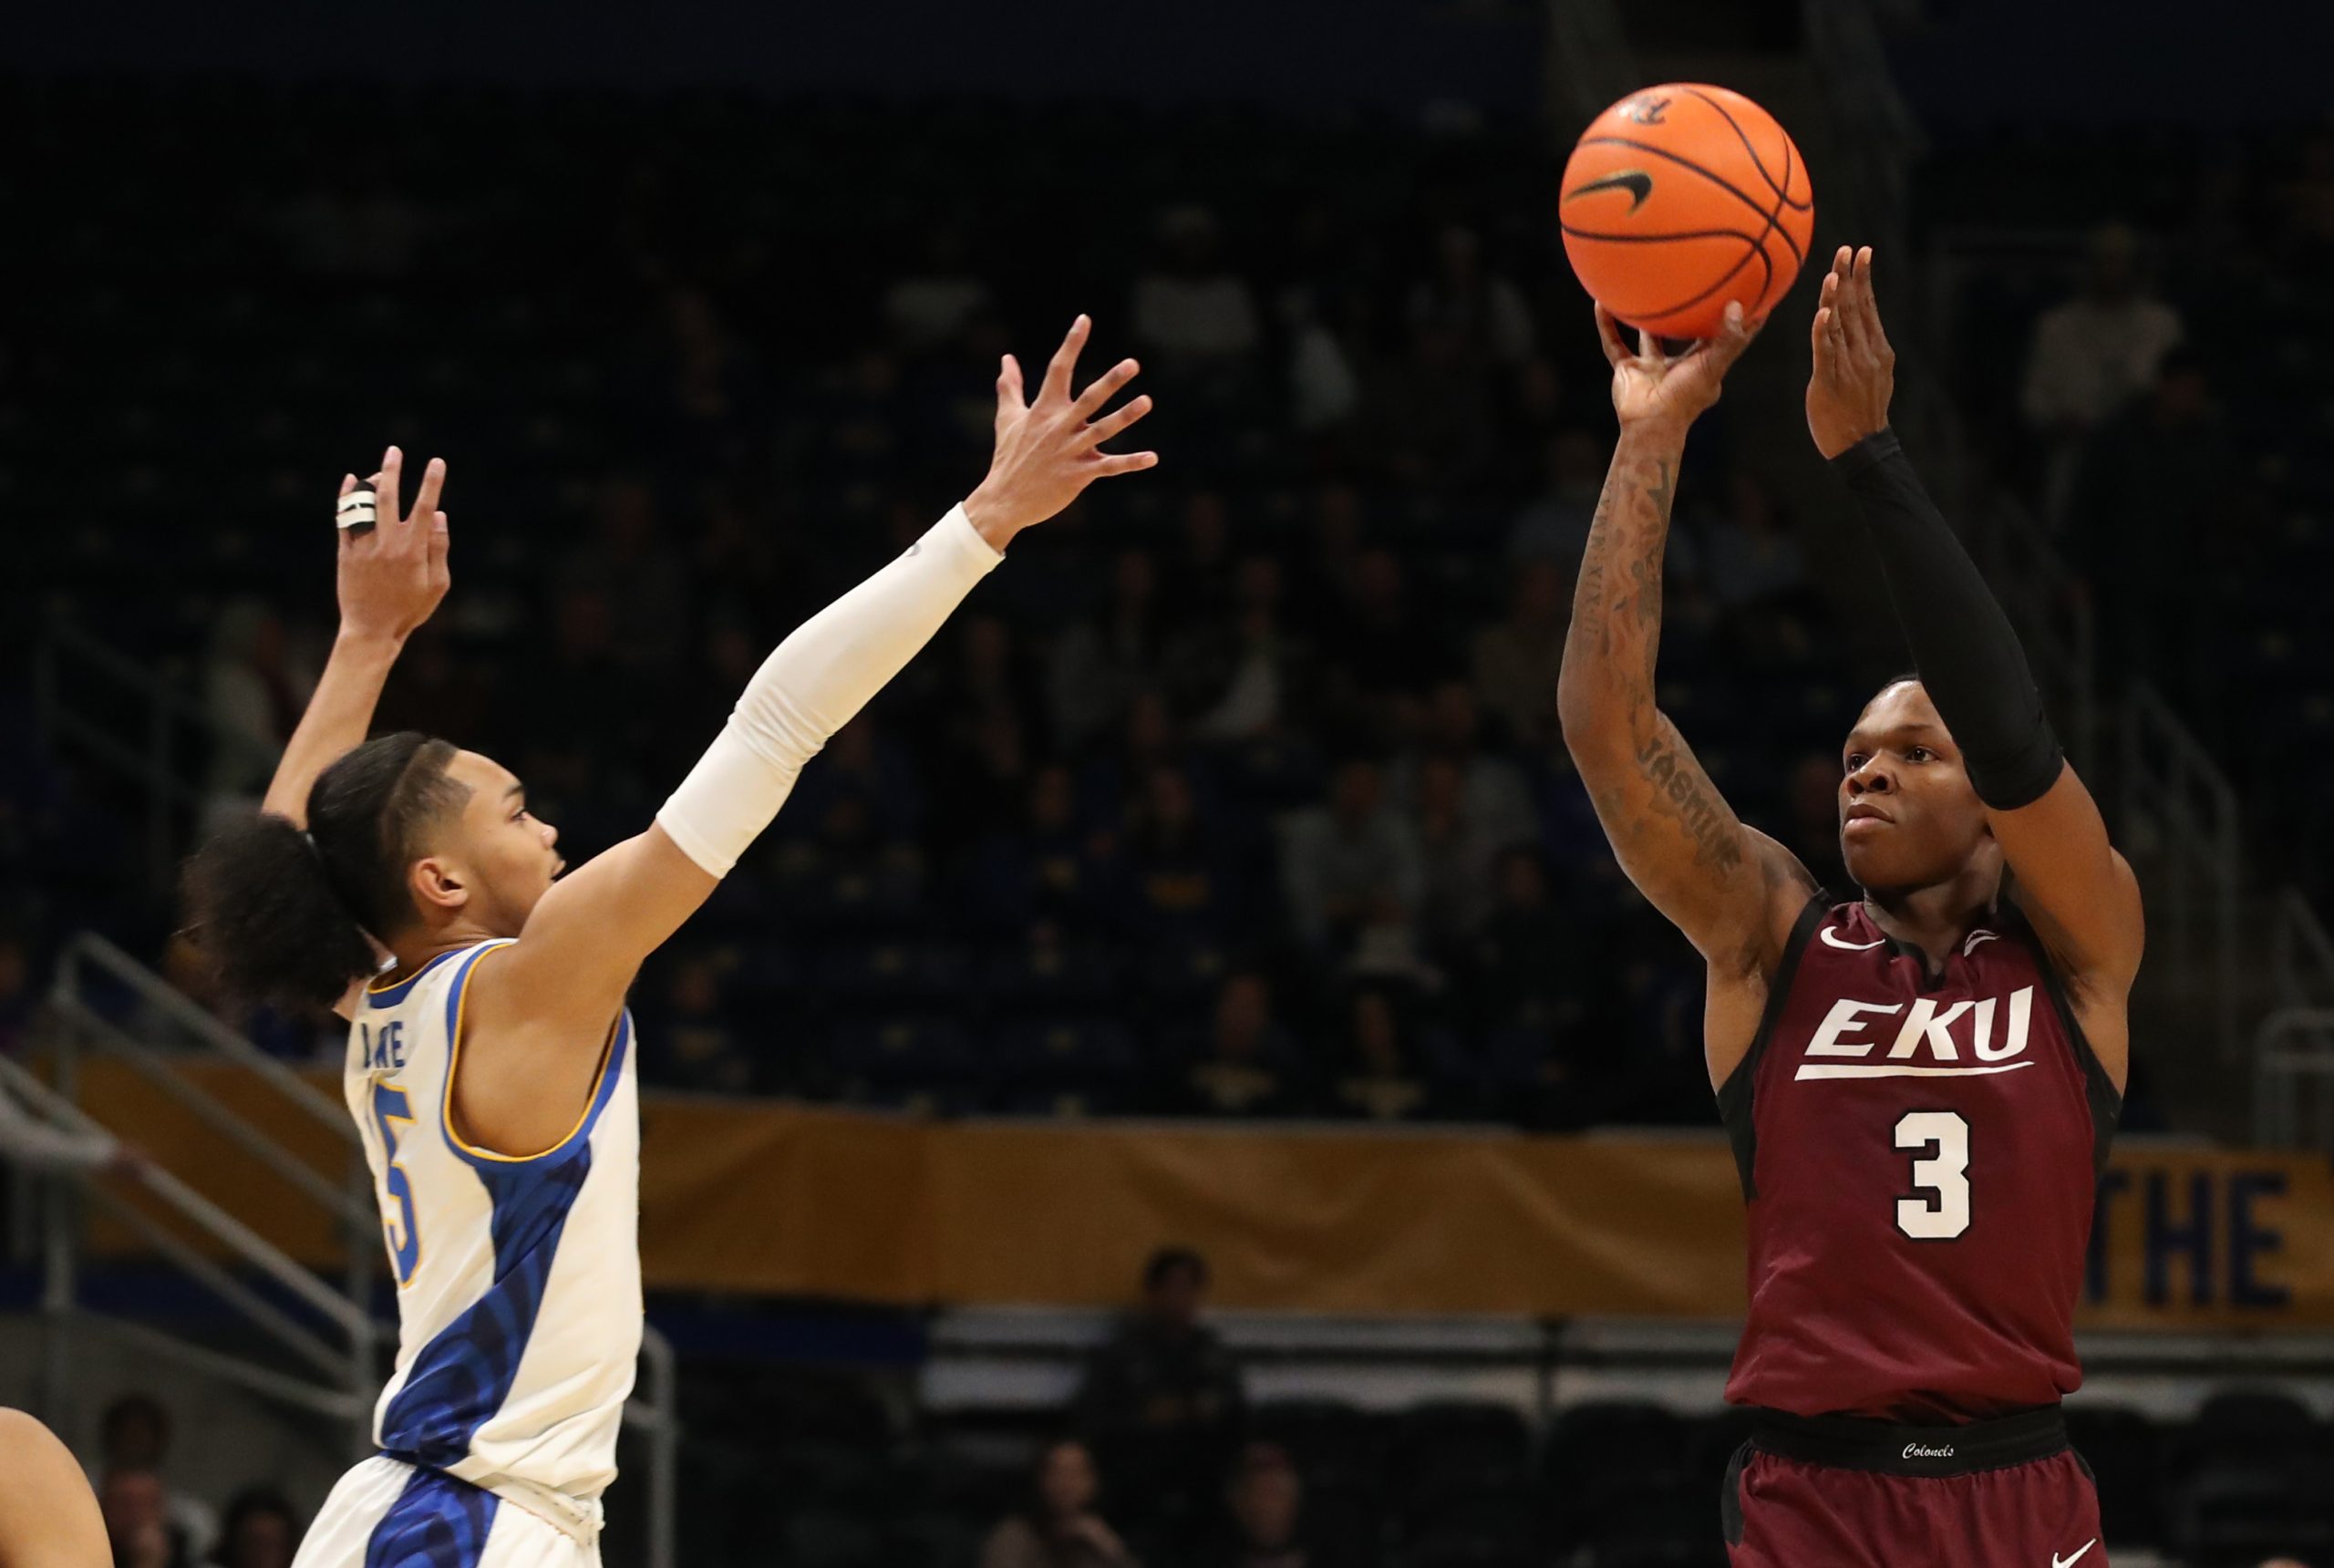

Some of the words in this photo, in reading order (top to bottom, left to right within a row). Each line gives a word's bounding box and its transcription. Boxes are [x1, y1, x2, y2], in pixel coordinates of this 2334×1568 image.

[1804, 985, 2033, 1061] EKU
[1892, 1109, 1971, 1241] 3
[1902, 1442, 1954, 1459] Colonels
